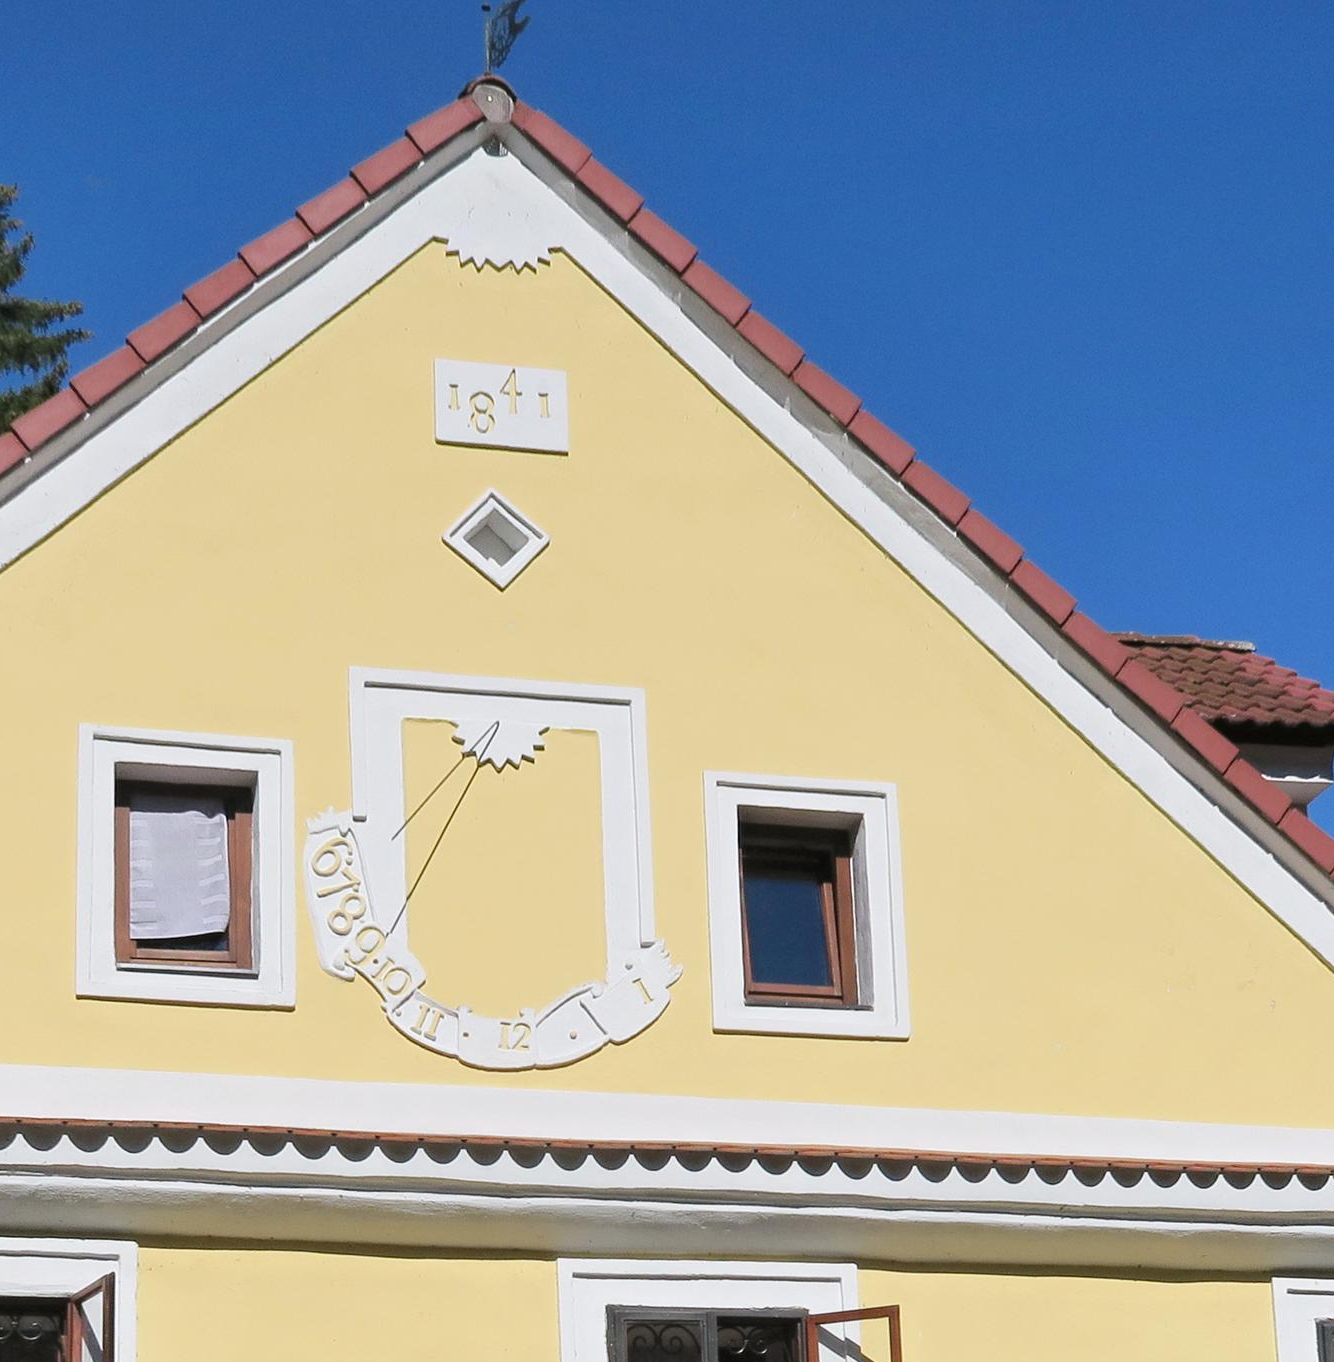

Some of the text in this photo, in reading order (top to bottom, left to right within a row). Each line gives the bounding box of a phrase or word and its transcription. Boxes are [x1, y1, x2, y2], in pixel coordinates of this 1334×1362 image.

[447, 367, 551, 434] 1841
[327, 892, 367, 936] 8
[498, 1021, 532, 1050] 12
